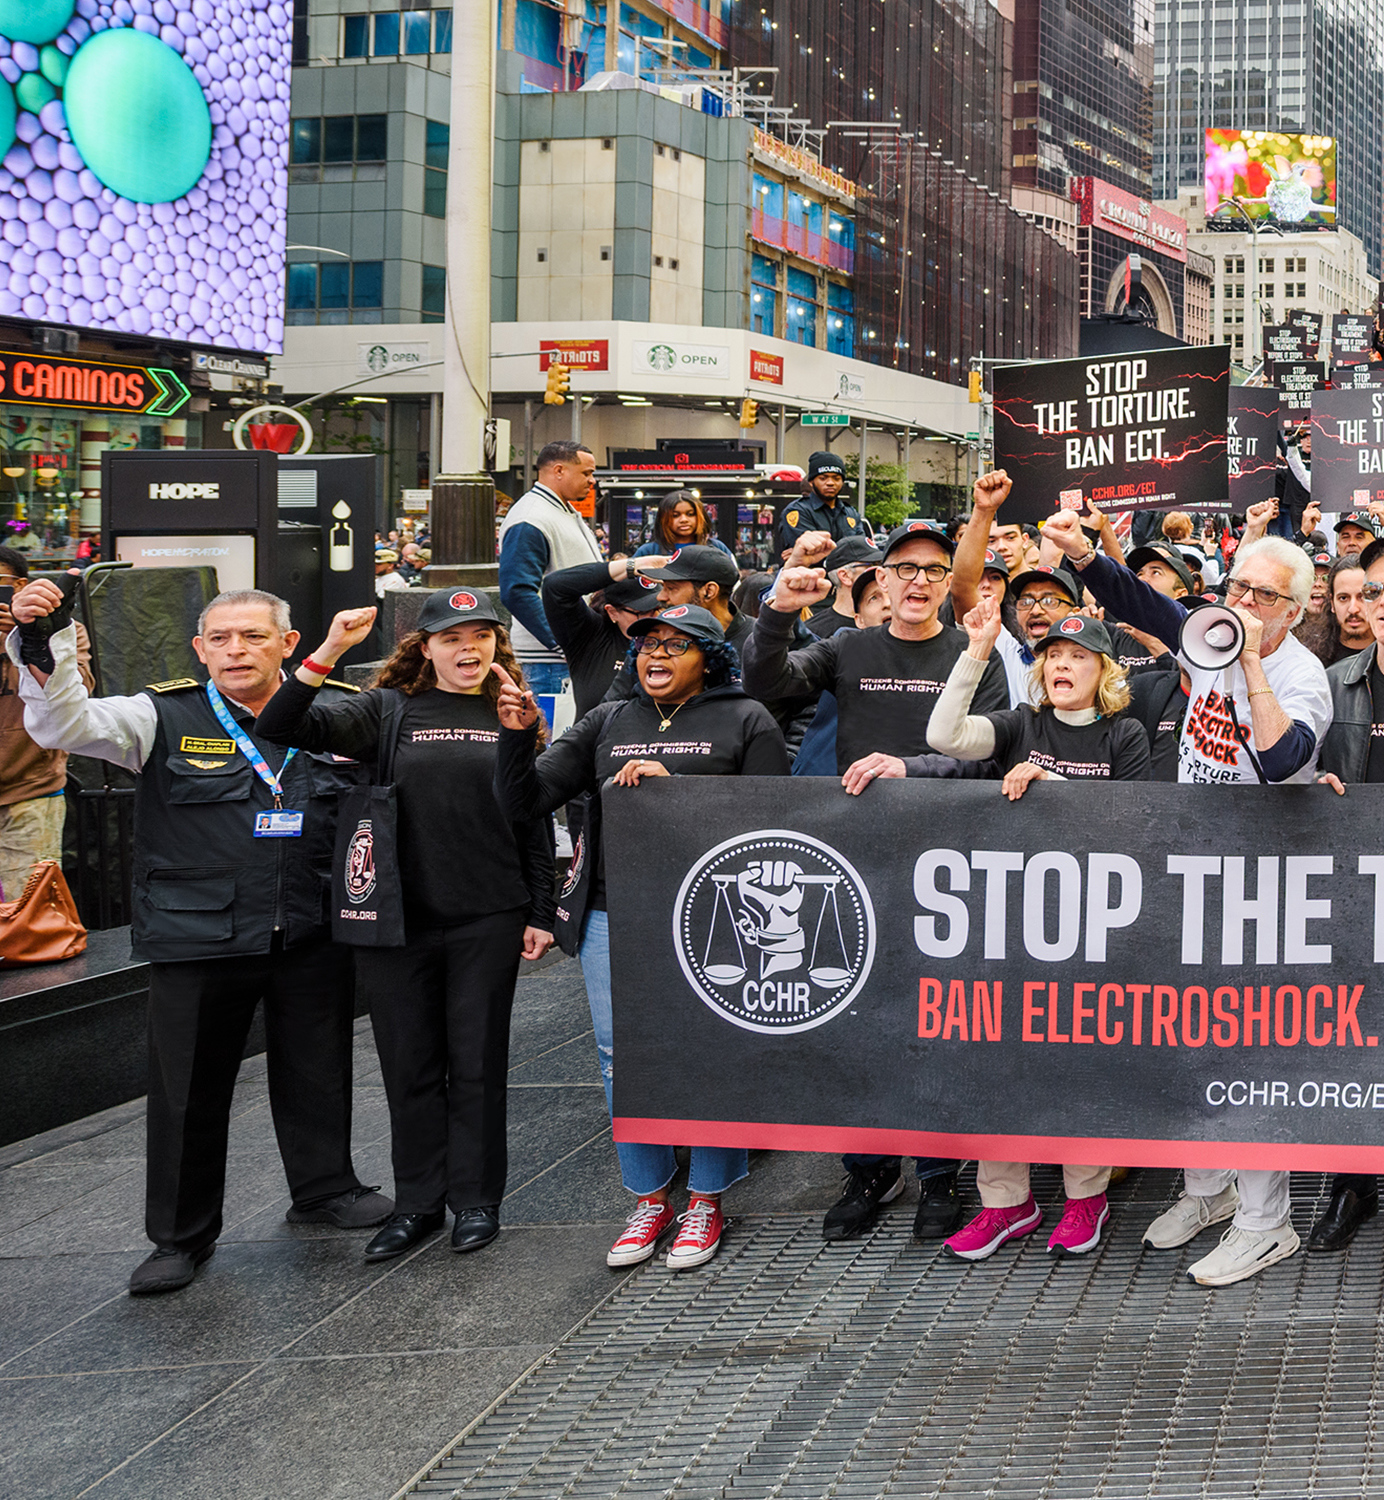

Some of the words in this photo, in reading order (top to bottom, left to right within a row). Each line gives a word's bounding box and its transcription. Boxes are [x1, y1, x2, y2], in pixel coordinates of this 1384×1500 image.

[391, 351, 420, 362] OPEN
[681, 354, 718, 365] OPEN
[1292, 366, 1306, 374] STOP
[13, 360, 145, 407] CAMINOS
[1086, 359, 1147, 397] STOP
[1281, 375, 1318, 383] ELECTROSHOCK
[1353, 373, 1370, 383] STOP
[1033, 399, 1078, 434] THE
[1087, 387, 1195, 428] TORTURE.
[812, 415, 820, 424] W
[820, 415, 830, 424] 47
[831, 415, 838, 424] St
[1337, 419, 1367, 444] THE
[1065, 435, 1114, 469] BAN
[1125, 428, 1170, 462] ECT.
[149, 483, 220, 499] HOPE
[1092, 482, 1157, 500] CCHR.ORG/ECT
[859, 683, 903, 693] HUMAN
[411, 728, 451, 737] CITIZENS
[412, 733, 465, 743] HUMAN
[610, 747, 658, 757] HUMAN
[662, 746, 711, 755] RIGHTS
[1067, 766, 1110, 776] RIGHTS
[912, 847, 1143, 963] STOP
[1167, 854, 1334, 966] THE
[743, 981, 811, 1014] CCHR
[917, 977, 1003, 1042] BAN
[1021, 980, 1379, 1048] ELECTROSHOCK.
